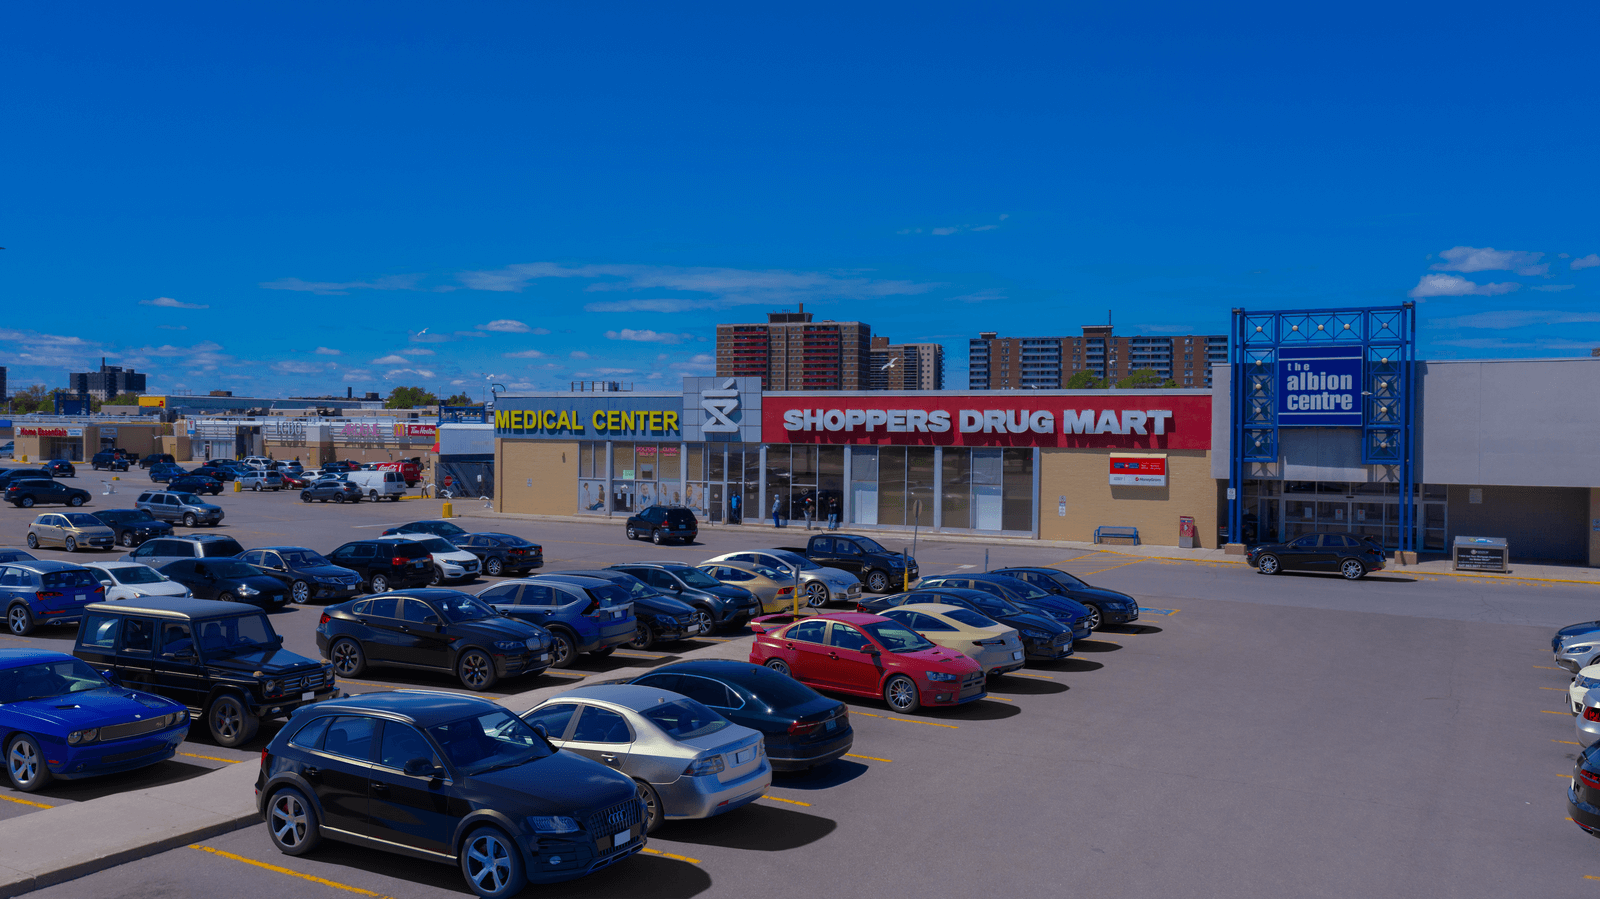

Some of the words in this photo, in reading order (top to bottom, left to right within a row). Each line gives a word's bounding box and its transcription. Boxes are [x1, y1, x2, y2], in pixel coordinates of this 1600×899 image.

[1287, 362, 1310, 371] the
[1287, 371, 1353, 391] albion
[1287, 391, 1353, 410] centre
[495, 410, 584, 430] MEDICAL
[592, 410, 679, 431] CENTER
[783, 409, 951, 433] SHOPPERS
[959, 409, 1055, 434] DRUG
[1063, 409, 1173, 435] MART
[20, 427, 37, 436] Home
[340, 423, 380, 437] ARDENE
[420, 426, 436, 434] Horton
